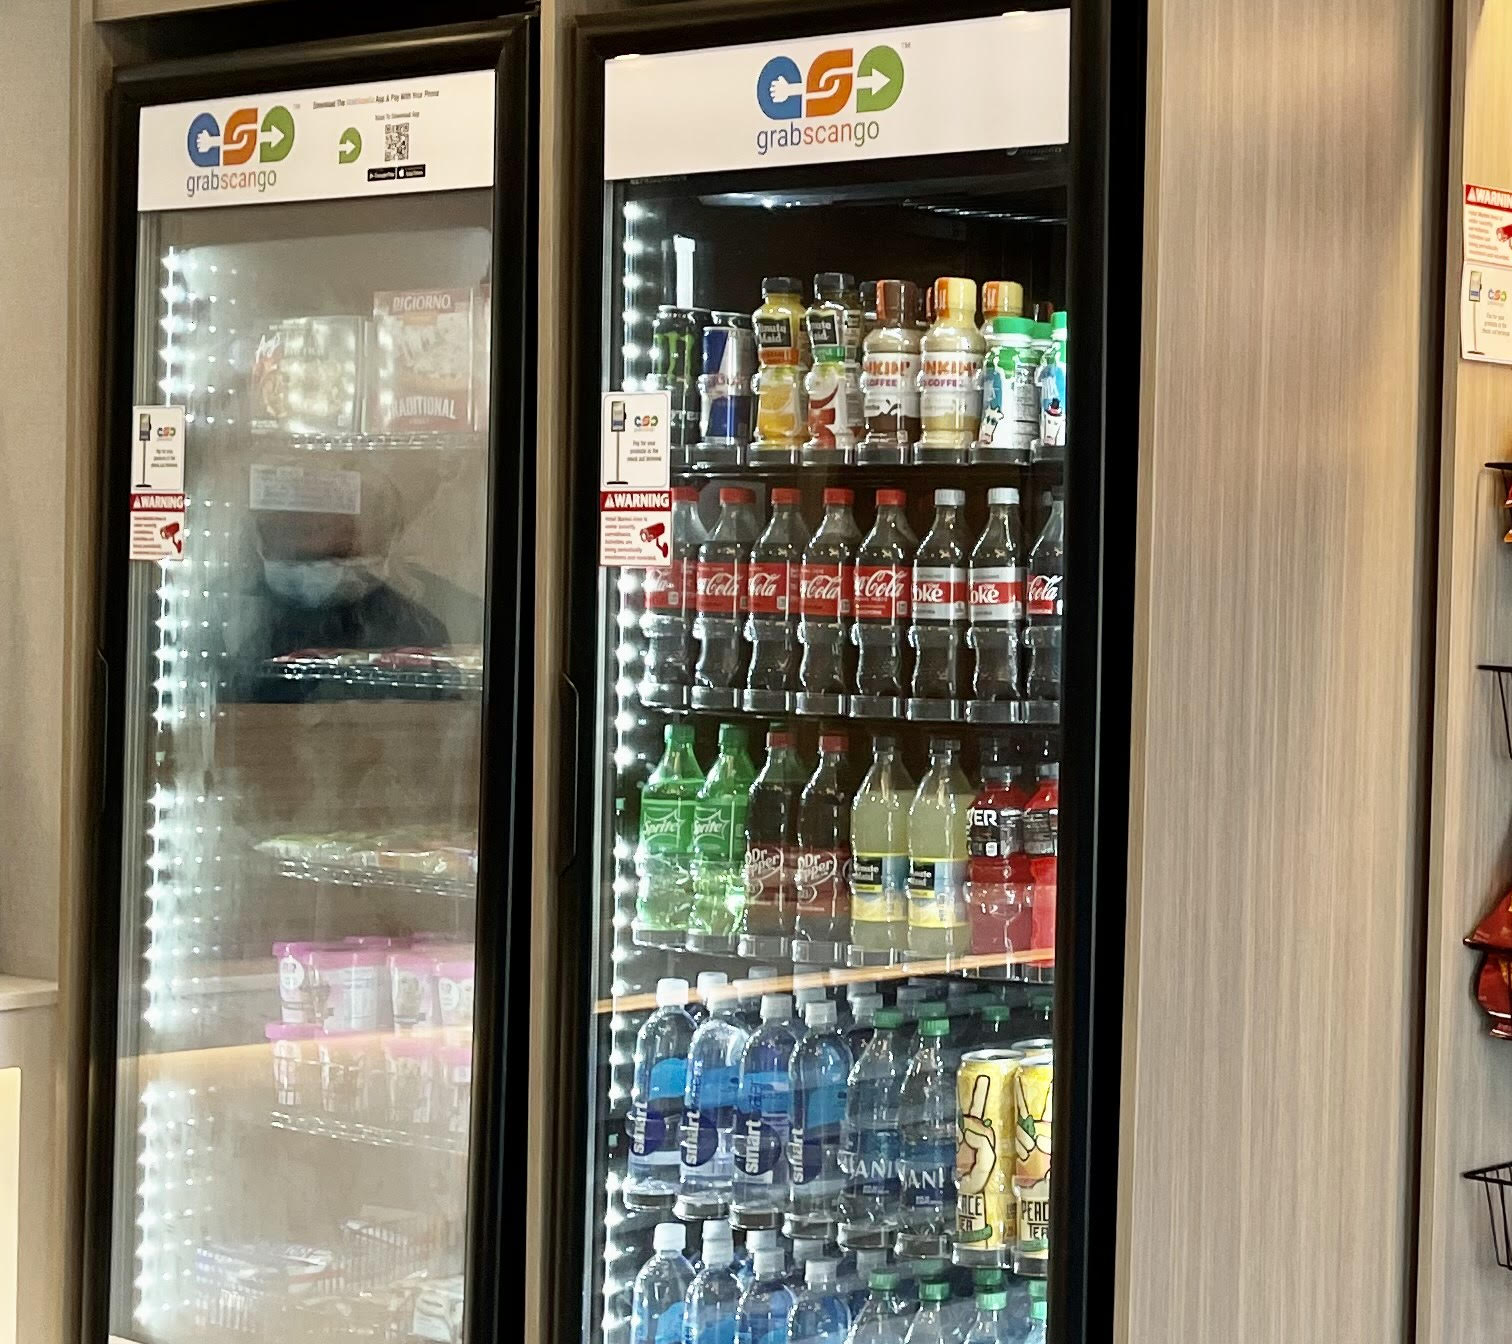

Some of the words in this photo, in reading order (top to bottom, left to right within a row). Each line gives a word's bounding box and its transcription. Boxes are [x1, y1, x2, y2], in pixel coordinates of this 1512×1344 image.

[756, 120, 880, 155] grabscango
[186, 168, 278, 198] grabscango
[140, 495, 183, 509] WARNING
[614, 493, 670, 508] WARNING
[912, 583, 943, 602] oke
[970, 583, 1000, 603] oke
[643, 819, 679, 835] Sprite
[683, 1109, 700, 1165] smart
[745, 1119, 762, 1174] smart
[791, 1127, 805, 1183] smart
[1021, 1200, 1050, 1222] PEAC
